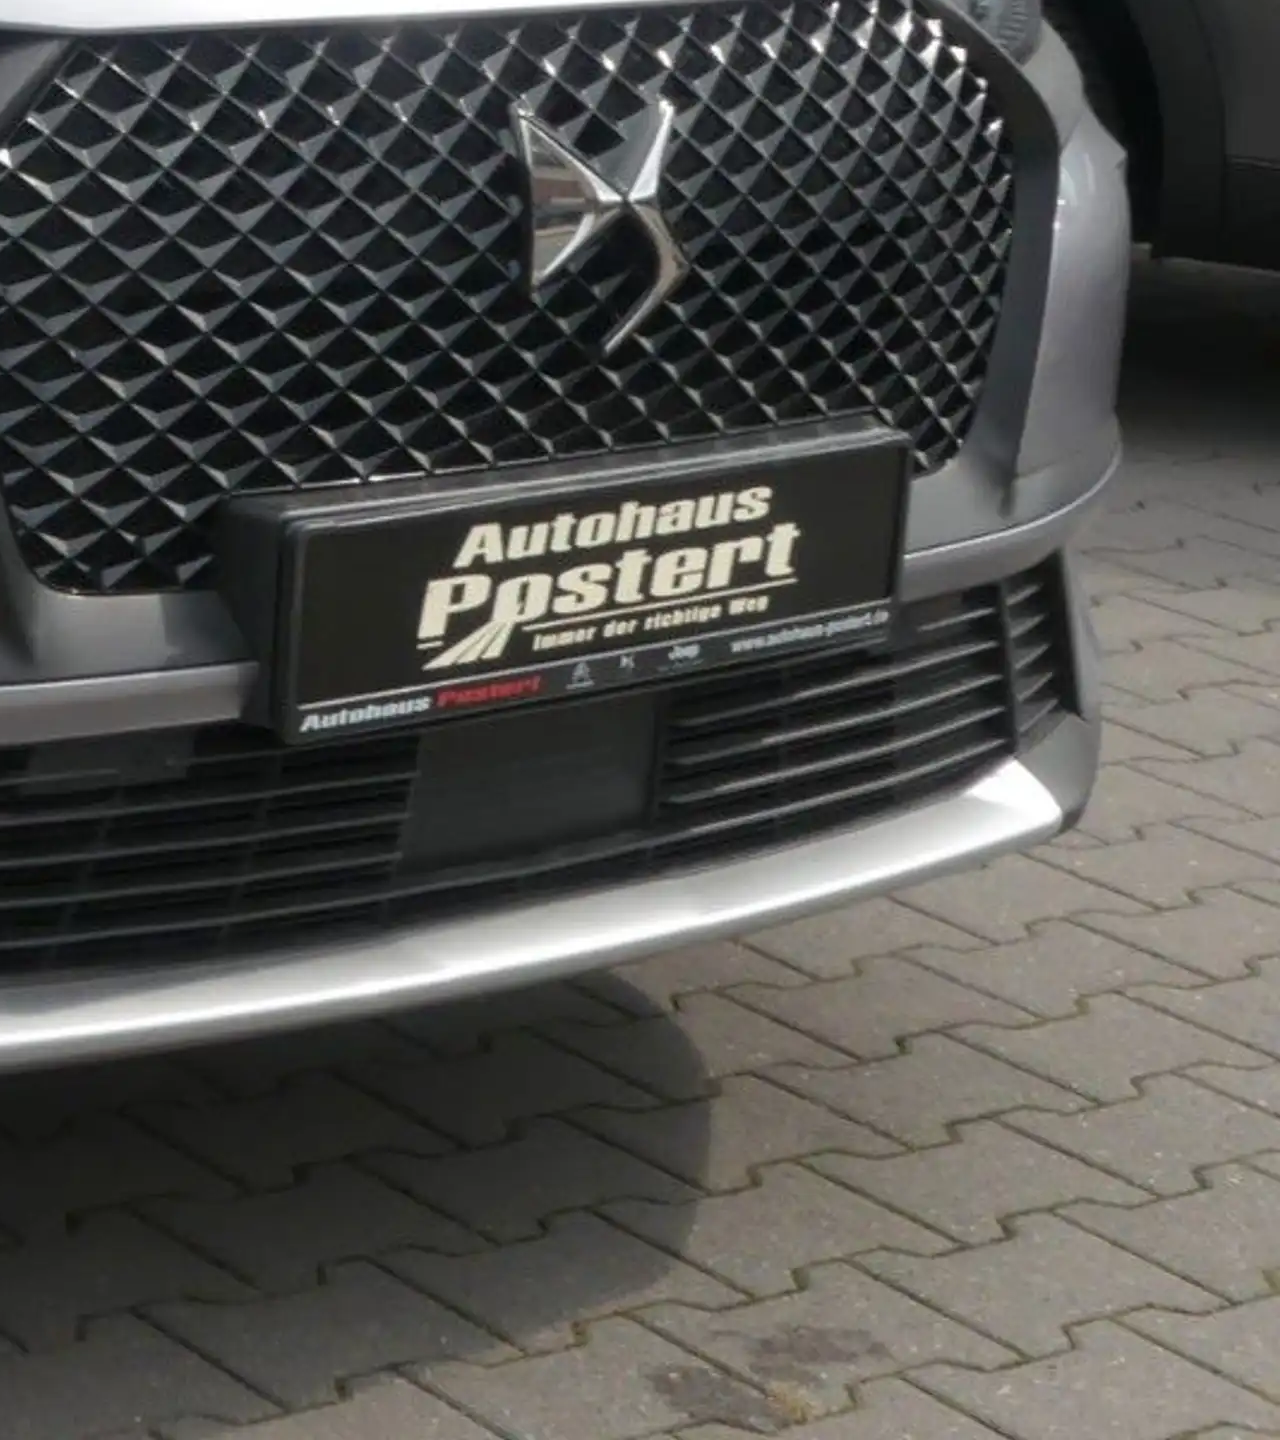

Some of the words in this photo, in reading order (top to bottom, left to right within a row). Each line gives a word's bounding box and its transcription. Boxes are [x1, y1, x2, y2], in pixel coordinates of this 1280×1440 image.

[451, 485, 774, 569] Autohaus
[415, 521, 802, 648] Postert
[602, 618, 639, 639] der
[643, 603, 724, 632] richtige
[299, 696, 431, 732] Autohaus
[436, 676, 542, 708] Postert
